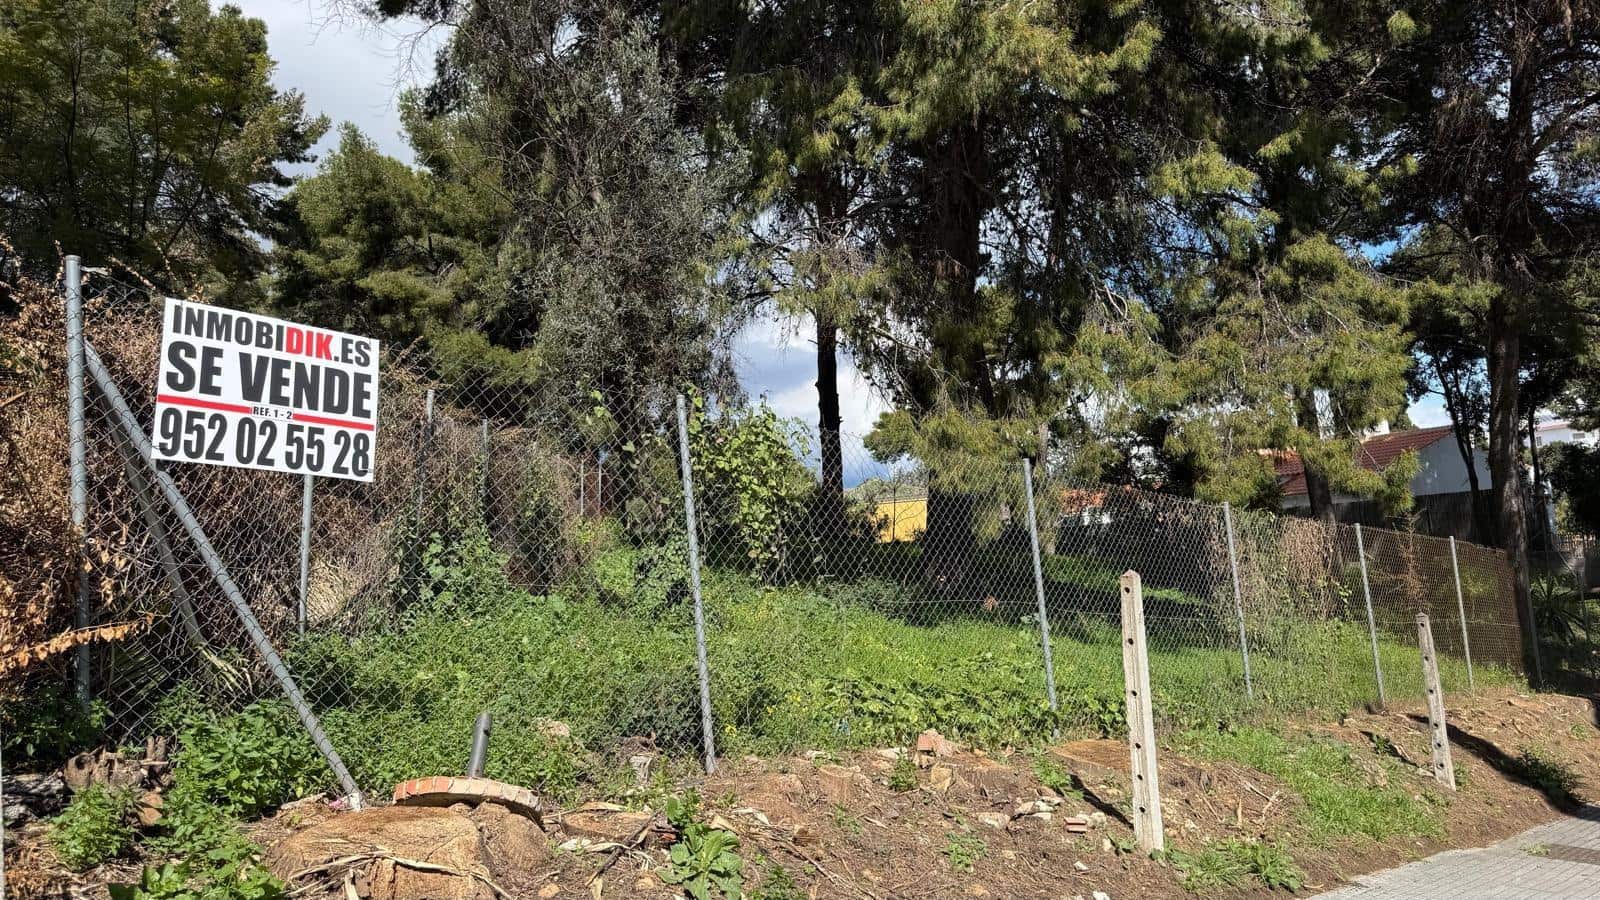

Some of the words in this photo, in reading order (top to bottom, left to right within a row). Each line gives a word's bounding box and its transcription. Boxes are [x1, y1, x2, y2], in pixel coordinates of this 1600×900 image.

[173, 304, 371, 367] INMOBIDIK.ES
[166, 341, 224, 396] SE
[239, 351, 372, 419] VENDE
[253, 406, 271, 417] REF.
[286, 410, 293, 419] 2
[159, 407, 228, 461] 952
[235, 417, 278, 467] 02
[285, 423, 325, 472] 55
[332, 430, 370, 477] 28
